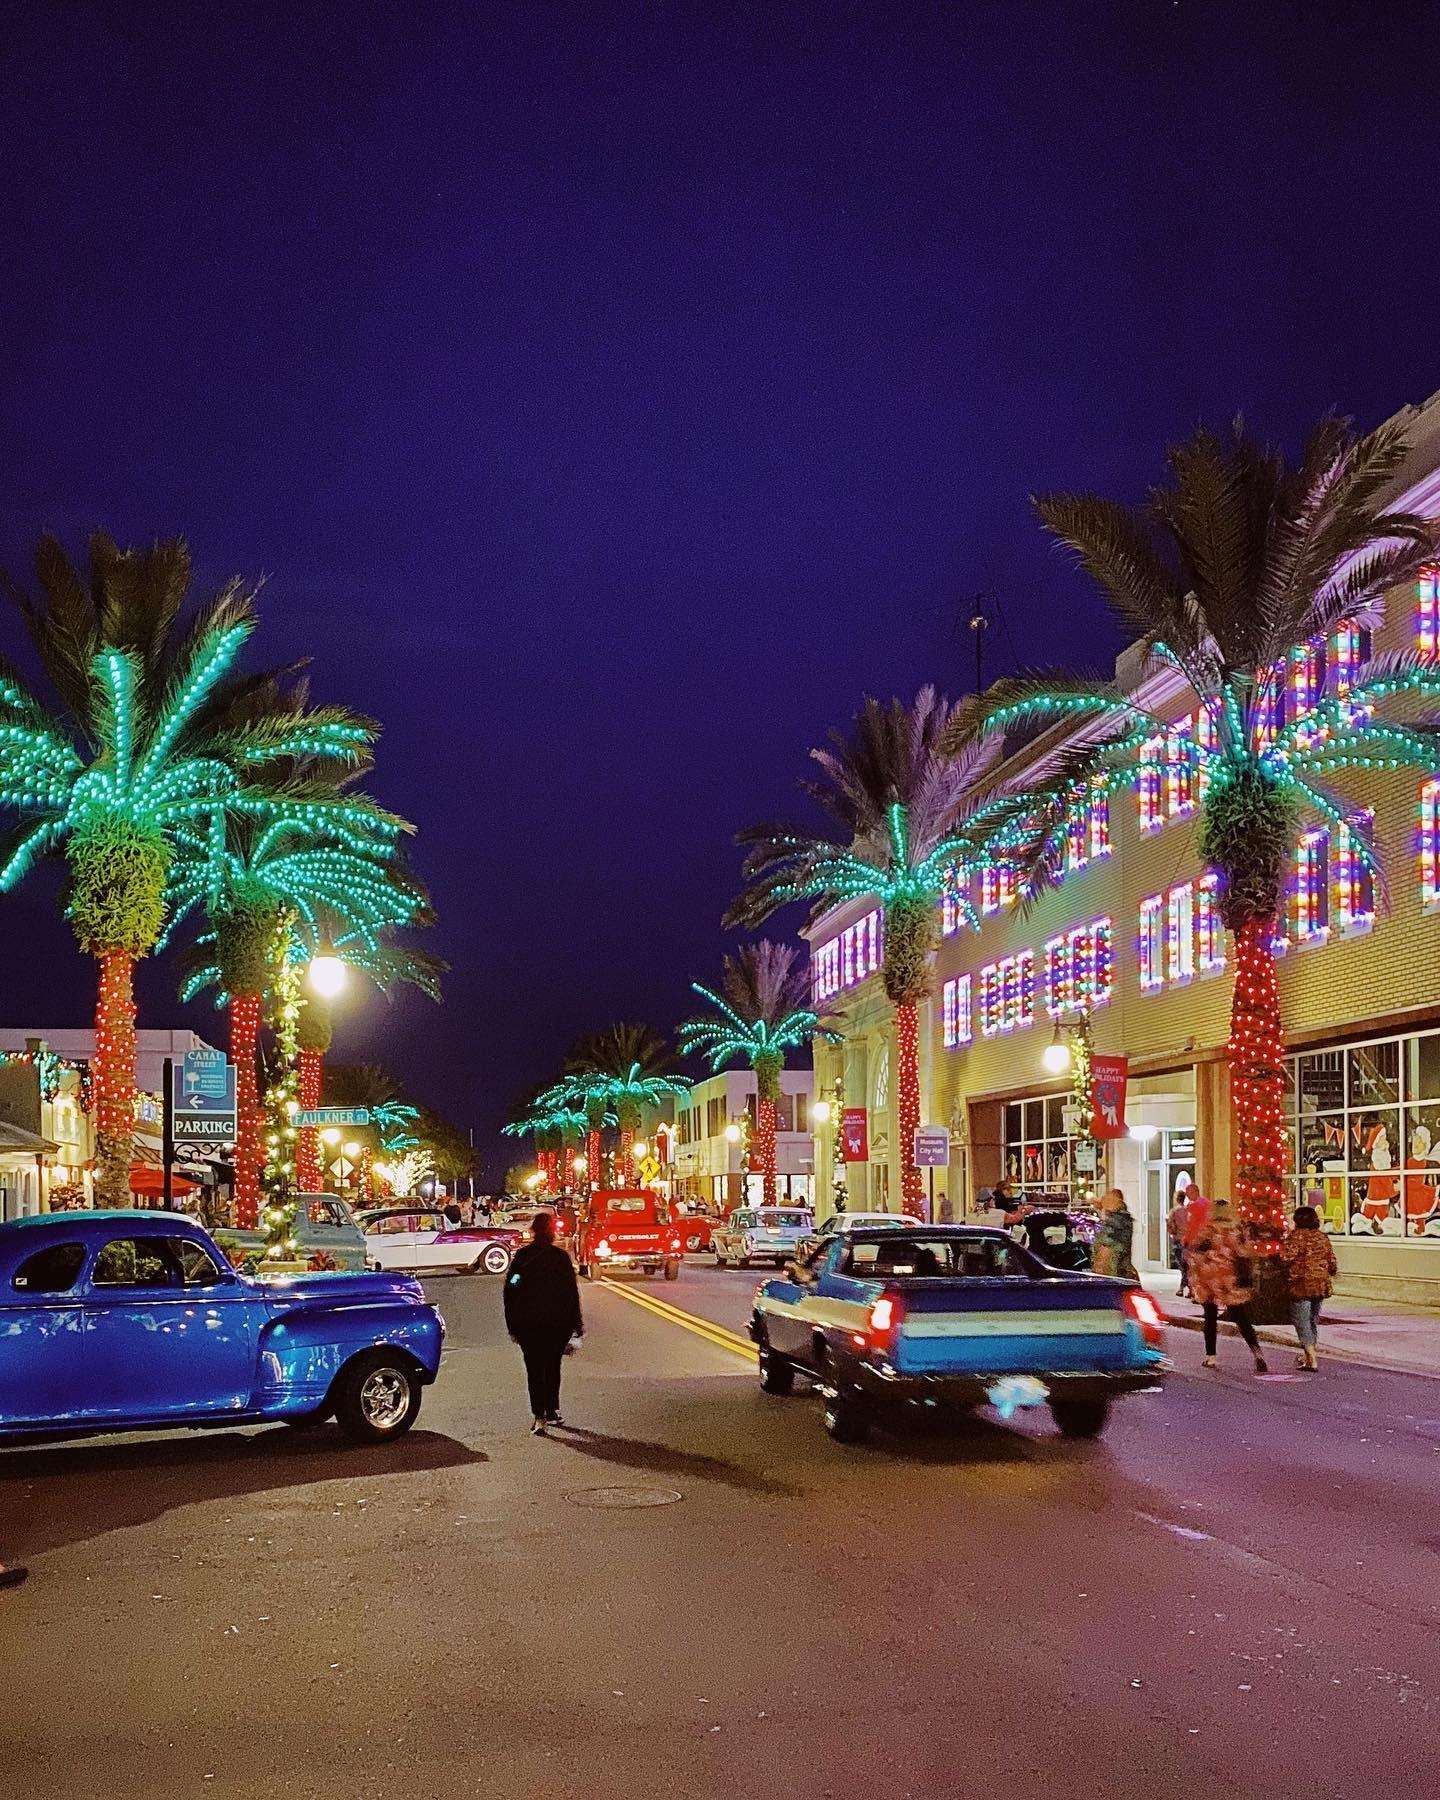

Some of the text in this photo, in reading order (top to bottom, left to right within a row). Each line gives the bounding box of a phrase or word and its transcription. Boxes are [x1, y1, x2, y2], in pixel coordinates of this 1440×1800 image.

[187, 1051, 222, 1061] CANAL
[1095, 1066, 1120, 1075] HAPPY
[295, 1111, 354, 1125] FAULKNER
[174, 1120, 234, 1135] PARKING
[919, 1147, 931, 1155] City
